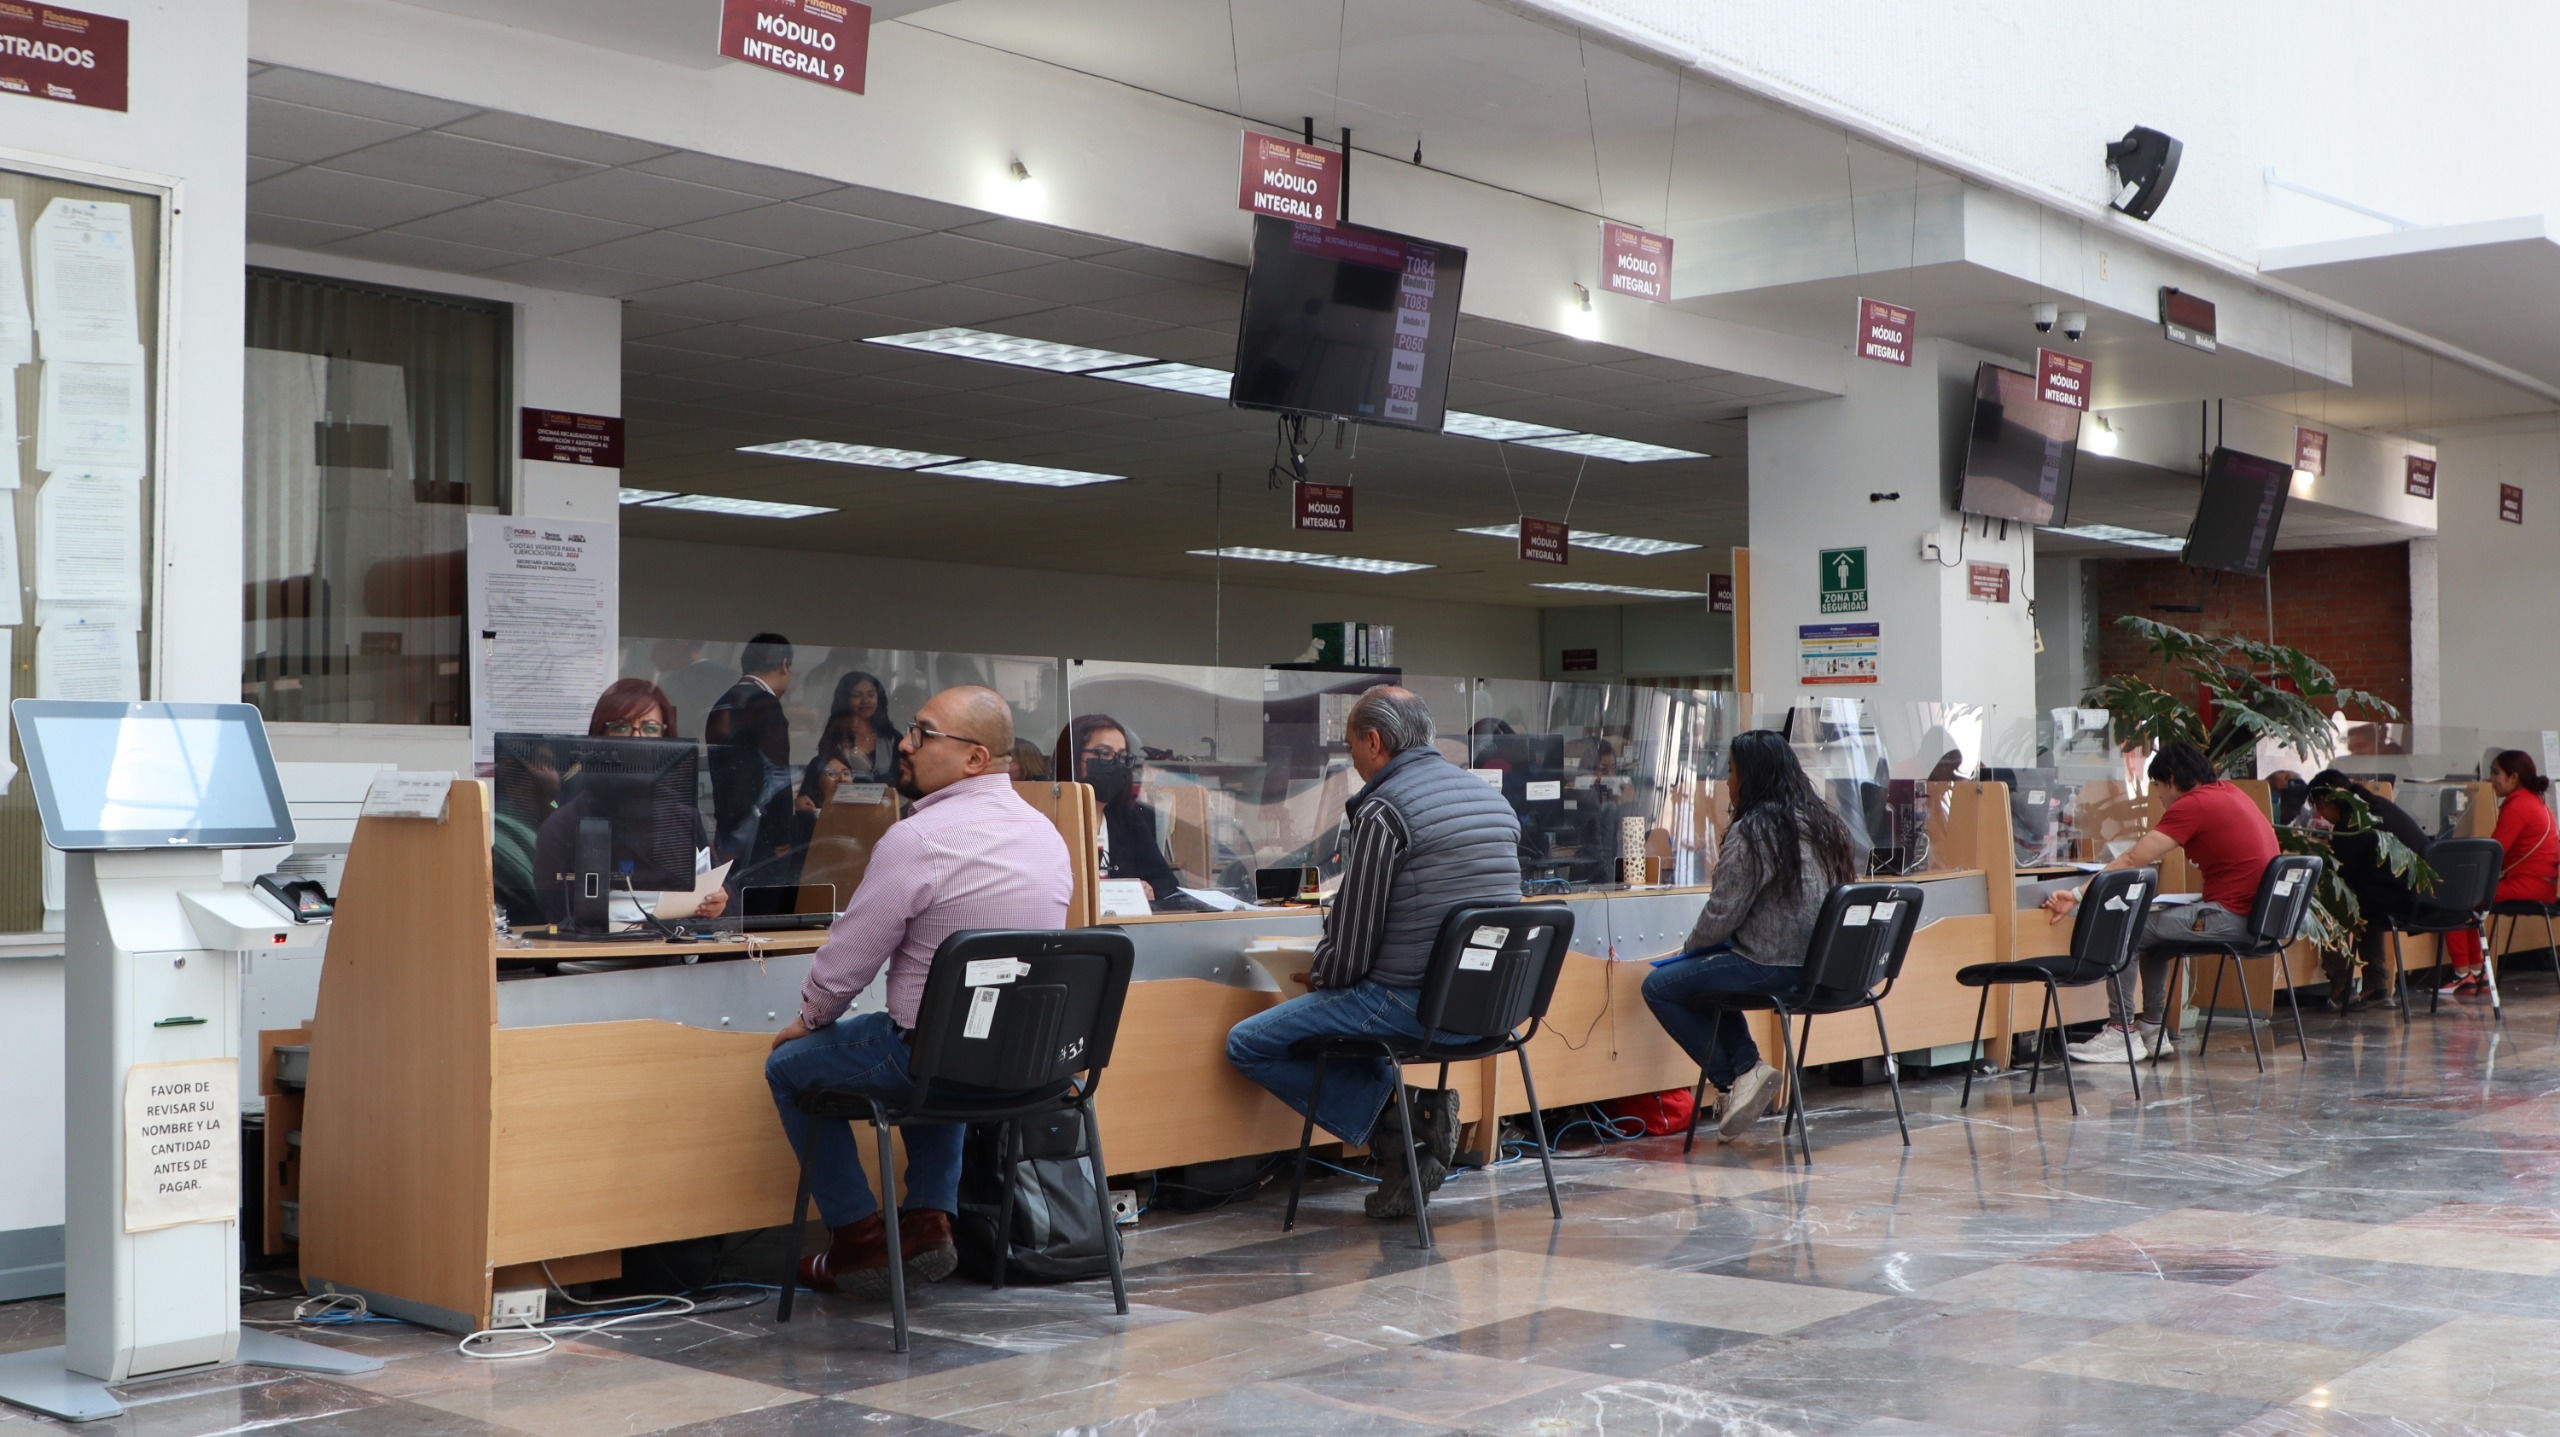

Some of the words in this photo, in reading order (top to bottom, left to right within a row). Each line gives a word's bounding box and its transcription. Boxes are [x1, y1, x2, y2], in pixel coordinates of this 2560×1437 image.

[757, 12, 836, 51] MÓDULO
[743, 37, 829, 79] INTEGRAL
[833, 64, 845, 82] 9
[1263, 168, 1317, 195] MÓDULO
[1254, 191, 1312, 218] INTEGRAL
[1314, 204, 1323, 220] 8
[1406, 255, 1435, 277] T084
[1618, 252, 1657, 275] MÓDULO
[1612, 273, 1654, 295] INTEGRAL
[1655, 283, 1661, 297] 7
[1404, 293, 1429, 311] T083
[1872, 324, 1903, 343] MÓDULO
[2168, 325, 2186, 341] Turno
[1398, 335, 1424, 351] P050
[1866, 342, 1900, 361] INTEGRAL
[1900, 350, 1905, 363] 6
[2050, 372, 2080, 390] MÓDULO
[1391, 384, 1417, 401] P049
[2045, 388, 2077, 406] INTEGRAL
[1308, 501, 1341, 515] MÓDULO
[1302, 516, 1338, 528] INTEGRAL
[1338, 519, 1346, 529] 17
[508, 542, 534, 550] CUOTAS
[561, 545, 577, 553] PARA
[1531, 534, 1558, 549] MÓDULO
[1526, 548, 1556, 561] INTEGRAL
[1824, 592, 1850, 603] ZONA
[1852, 591, 1865, 602] DE
[1822, 600, 1867, 613] SEGURIDAD
[151, 1083, 191, 1097] FAVOR
[195, 1082, 210, 1093] DE
[147, 1102, 196, 1117] REVISAR
[200, 1100, 215, 1112] SU
[142, 1121, 194, 1137] NOMBRE
[197, 1121, 204, 1132] Y
[206, 1119, 220, 1130] LA
[151, 1139, 211, 1156] CANTIDAD
[153, 1160, 190, 1175] ANTES
[193, 1159, 208, 1170] DE
[159, 1179, 202, 1194] PAGAR.
